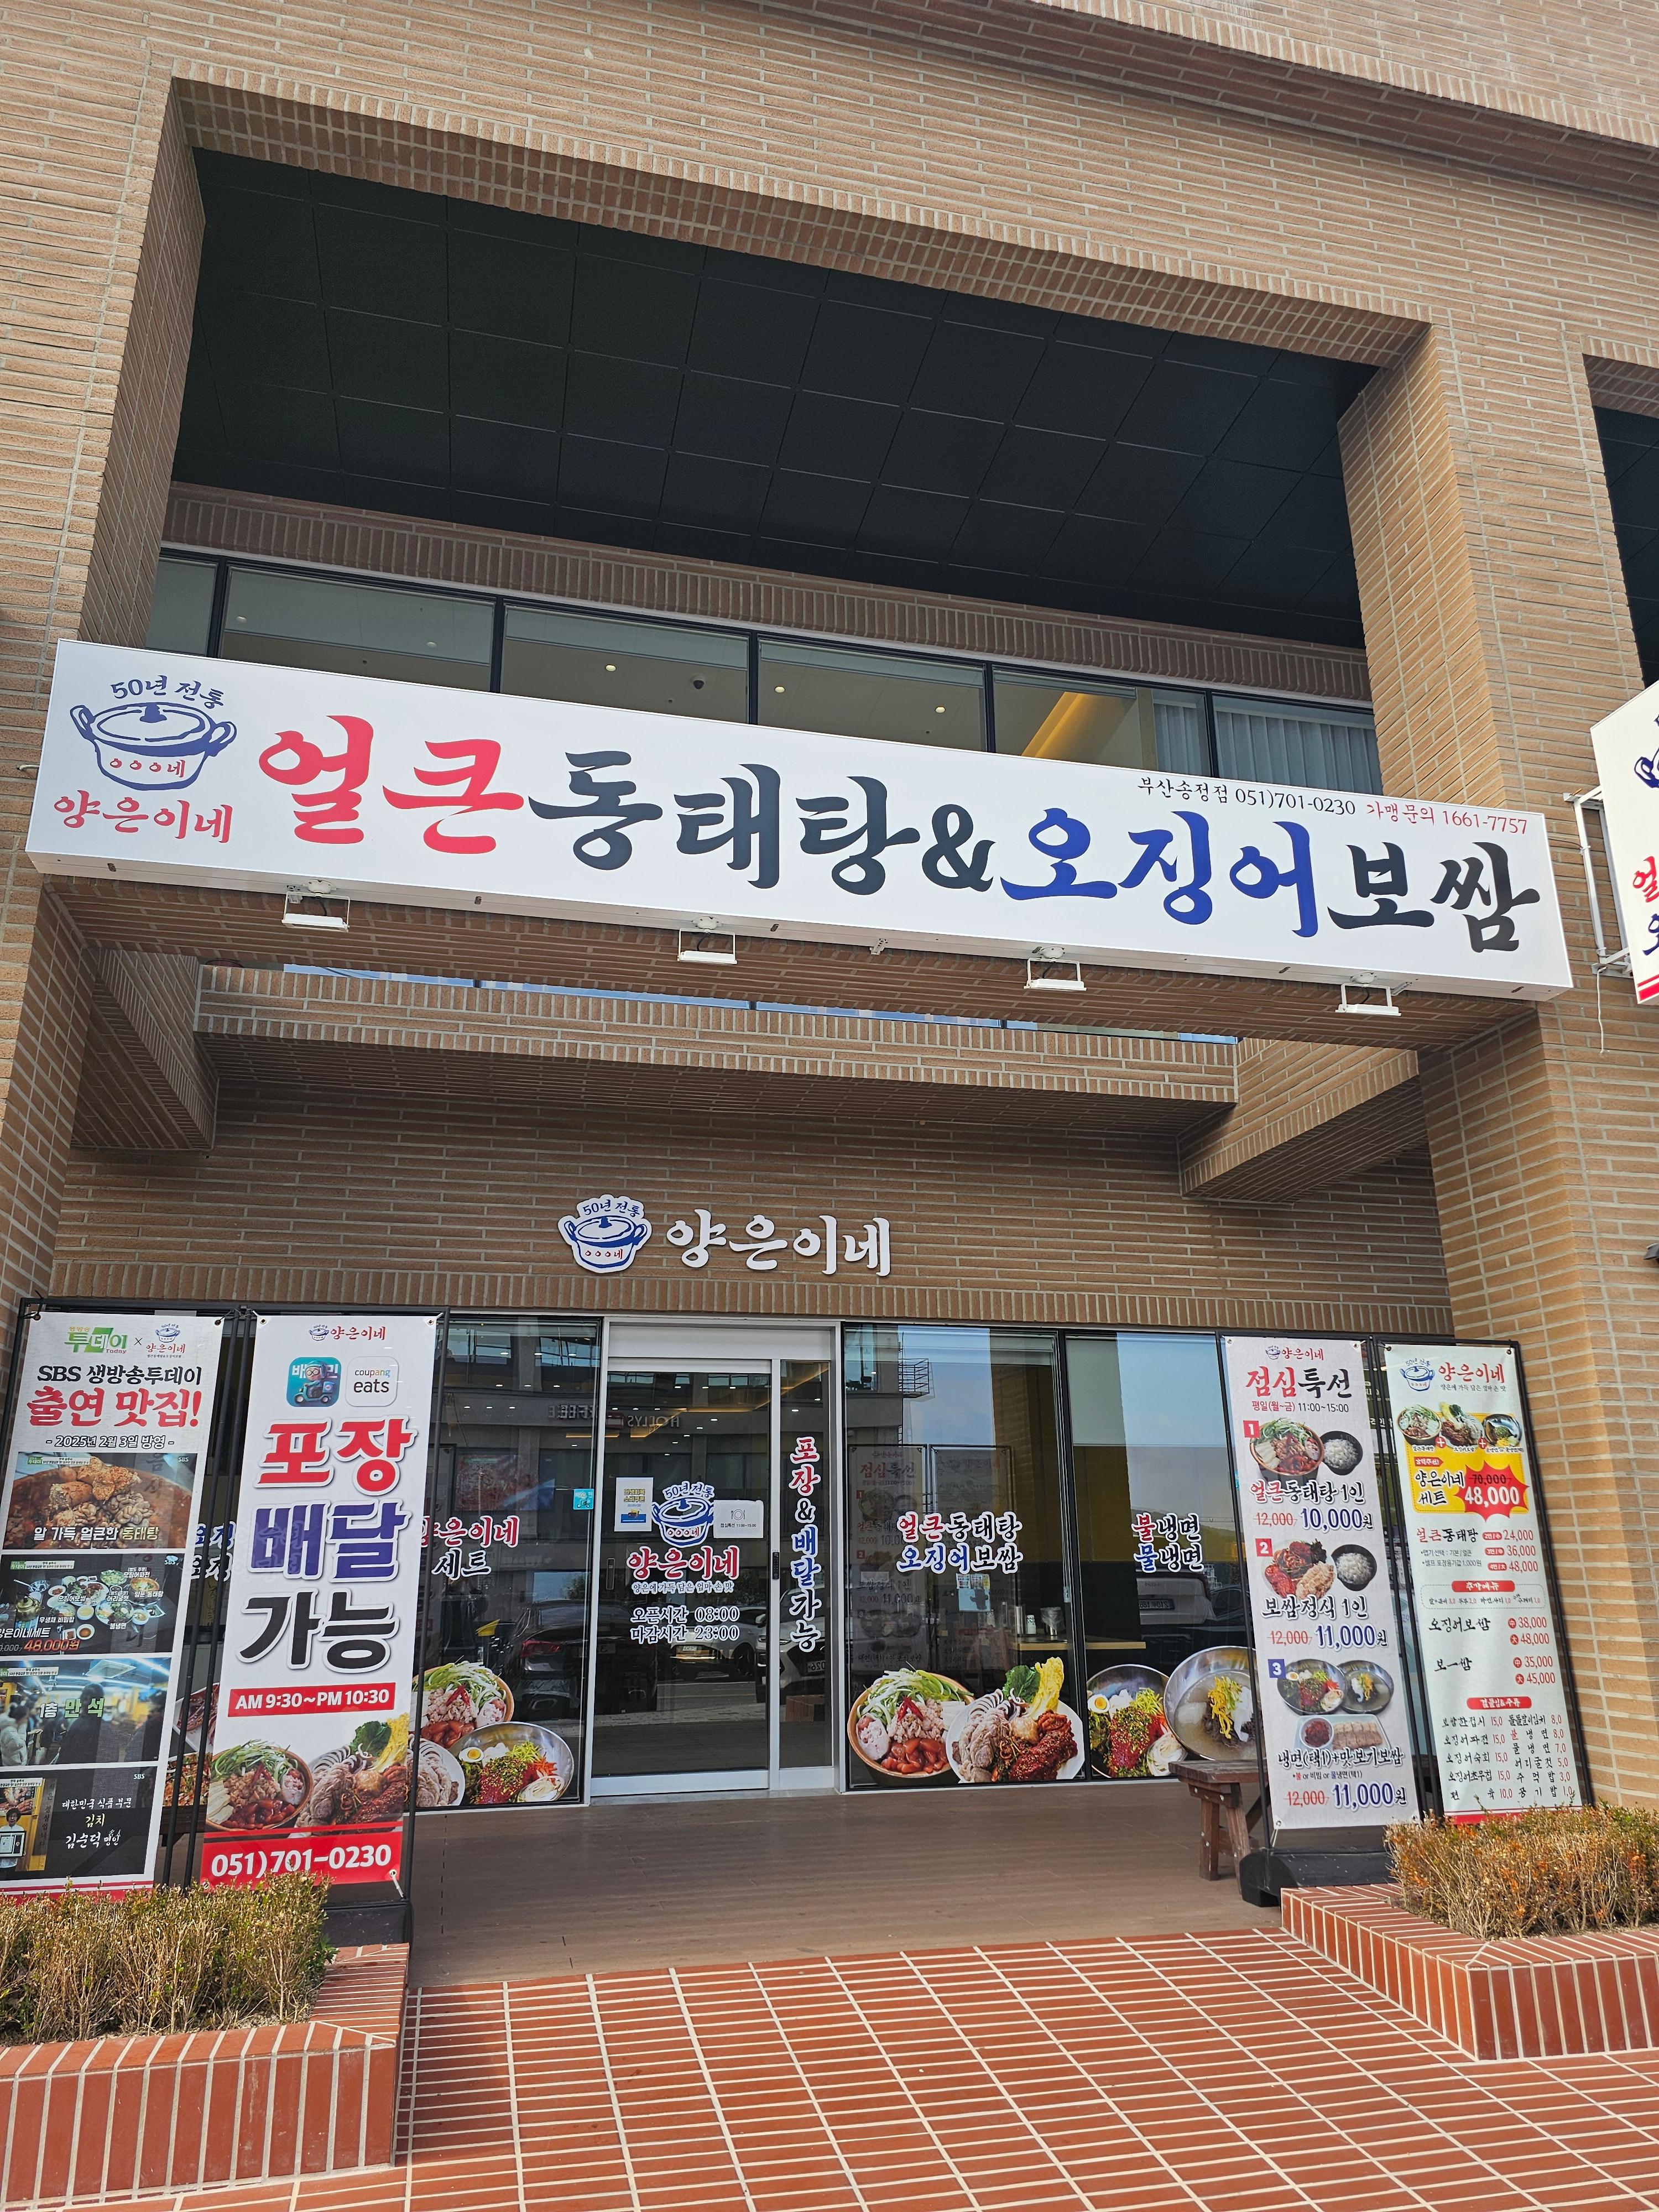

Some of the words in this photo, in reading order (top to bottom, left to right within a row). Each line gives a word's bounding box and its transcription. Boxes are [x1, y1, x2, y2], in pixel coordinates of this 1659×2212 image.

[111, 675, 168, 700] 50년
[178, 680, 225, 709] 전통
[1138, 776, 1228, 804] 부산송정점
[1235, 789, 1356, 816] 051)701-0230
[1442, 810, 1528, 835] 1661-7757
[54, 790, 233, 844] 양은이네
[582, 1199, 612, 1215] 50년
[615, 1201, 640, 1217] 전통
[666, 1209, 891, 1276] 양은이네
[64, 1330, 128, 1353] 투데이
[331, 1326, 386, 1340] 양은이네
[146, 1343, 186, 1354] 양은이네
[1282, 1347, 1324, 1360] 양은이네
[38, 1365, 81, 1383] SBS
[86, 1364, 202, 1385] 생방송투데이
[355, 1368, 390, 1378] coupang
[1438, 1362, 1505, 1383] 양은이네
[353, 1379, 389, 1394] eats
[1245, 1366, 1352, 1399] 점심특선
[27, 1385, 105, 1427] 출연
[114, 1387, 202, 1428] 맛집!
[1251, 1401, 1296, 1412] 평일(월~금)
[1298, 1403, 1349, 1413] 11:00~15:00
[1248, 1424, 1254, 1435] 1
[54, 1435, 97, 1447] 2025년
[100, 1436, 117, 1448] 2월
[120, 1435, 139, 1448] 3일
[141, 1435, 166, 1449] 방영
[255, 1417, 416, 1493] 포장
[1415, 1470, 1465, 1487] 양은이네
[664, 1482, 688, 1498] 50년
[691, 1483, 714, 1498] 전통
[1250, 1480, 1337, 1503] 얼큰동태탕
[1340, 1481, 1365, 1503] 1인
[1418, 1490, 1448, 1506] 세트
[1465, 1486, 1520, 1507] 48,000
[897, 1512, 1022, 1542] 얼큰동태탕
[1132, 1513, 1201, 1542] 불냉면
[1256, 1512, 1293, 1527] 12,000
[1300, 1508, 1374, 1532] 10,000원
[34, 1527, 48, 1541] 알
[51, 1526, 76, 1541] 가득
[80, 1526, 119, 1541] 얼큰한
[122, 1526, 160, 1541] 동태탕
[251, 1501, 410, 1579] 배달
[1417, 1527, 1478, 1543] 얼큰동태탕
[1504, 1530, 1533, 1542] 24,000
[1134, 1542, 1204, 1572] 물냉면
[1259, 1542, 1269, 1554] 2
[1506, 1545, 1536, 1557] 36,000
[431, 1547, 492, 1580] 세트
[627, 1545, 739, 1580] 양은이네
[897, 1543, 1022, 1573] 오징어보쌈
[1509, 1561, 1538, 1573] 48,000
[632, 1582, 658, 1594] 양은에
[658, 1581, 676, 1594] 가득
[677, 1581, 695, 1593] 담은
[696, 1581, 713, 1593] 엄마
[630, 1605, 689, 1624] 오픈시간
[695, 1606, 740, 1622] 08:00
[1261, 1595, 1337, 1619] 보쌈정식
[1341, 1595, 1369, 1618] 1인
[238, 1590, 396, 1670] 가능
[1428, 1616, 1490, 1632] 오징어보쌈
[1518, 1617, 1547, 1629] 38,000
[630, 1624, 688, 1644] 마감시간
[695, 1625, 740, 1641] 23:00
[1270, 1631, 1308, 1646] 12,000
[1315, 1625, 1387, 1650] 11,000원
[1521, 1633, 1550, 1645] 48,000
[24, 1639, 81, 1652] 48,000원
[1272, 1662, 1282, 1676] 3
[1524, 1656, 1553, 1668] 35,000
[1526, 1672, 1556, 1684] 45,000
[235, 1695, 263, 1710] AM
[345, 1688, 390, 1705] 10:30
[39, 1702, 58, 1718] 1층
[1444, 1734, 1489, 1745] 오징어파전
[1446, 1752, 1490, 1764] 오징어숙회
[62, 1798, 95, 1810] 대한민국
[97, 1797, 114, 1809] 식품
[115, 1797, 132, 1808] 부문
[1287, 1790, 1325, 1807] 12,000
[1332, 1783, 1407, 1809] 11,000원
[85, 1813, 106, 1828] 김치
[65, 1831, 101, 1849] 김순덕
[211, 1844, 392, 1878] 051)701-0230
